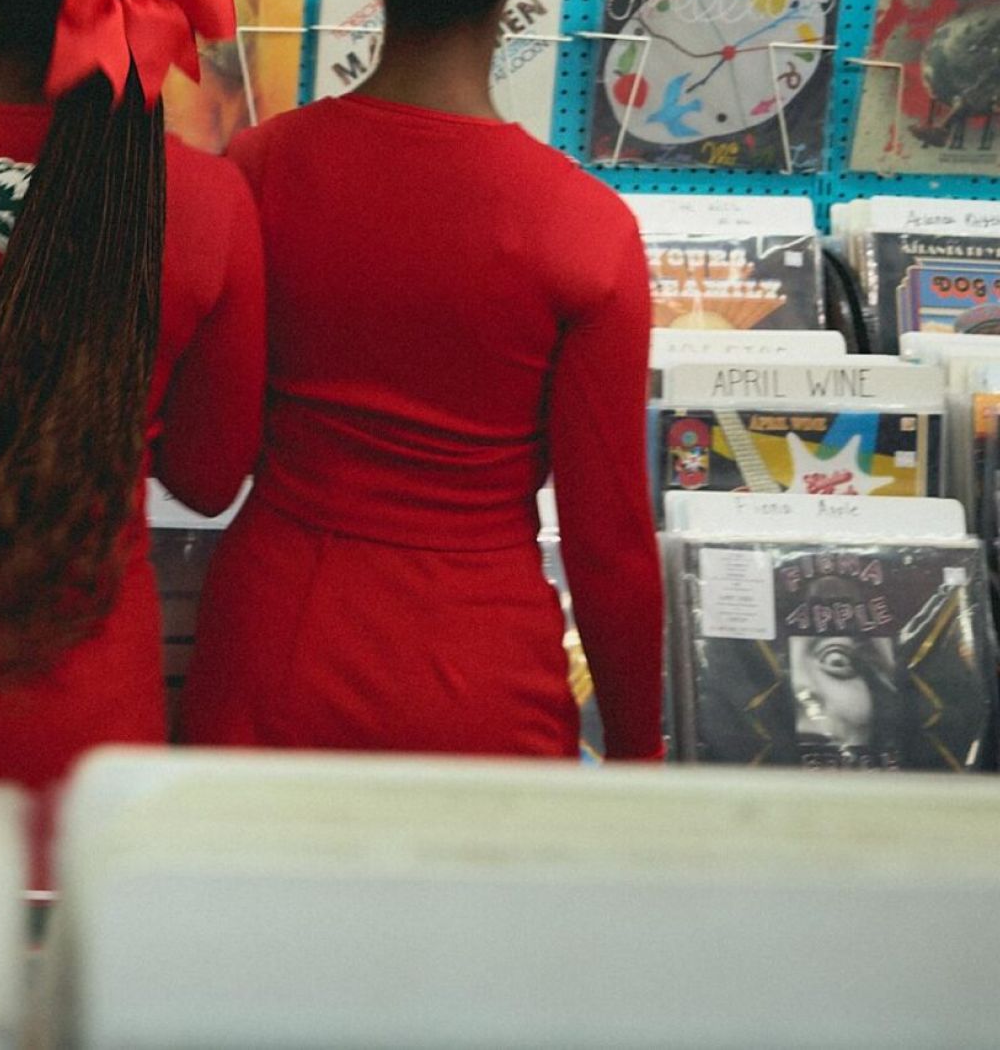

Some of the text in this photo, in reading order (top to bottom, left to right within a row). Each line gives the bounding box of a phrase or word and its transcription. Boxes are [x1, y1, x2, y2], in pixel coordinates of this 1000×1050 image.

[930, 275, 988, 303] DOG
[711, 368, 877, 399] APRIL WINE
[779, 552, 883, 592] FIONA
[784, 596, 893, 634] APPLE
